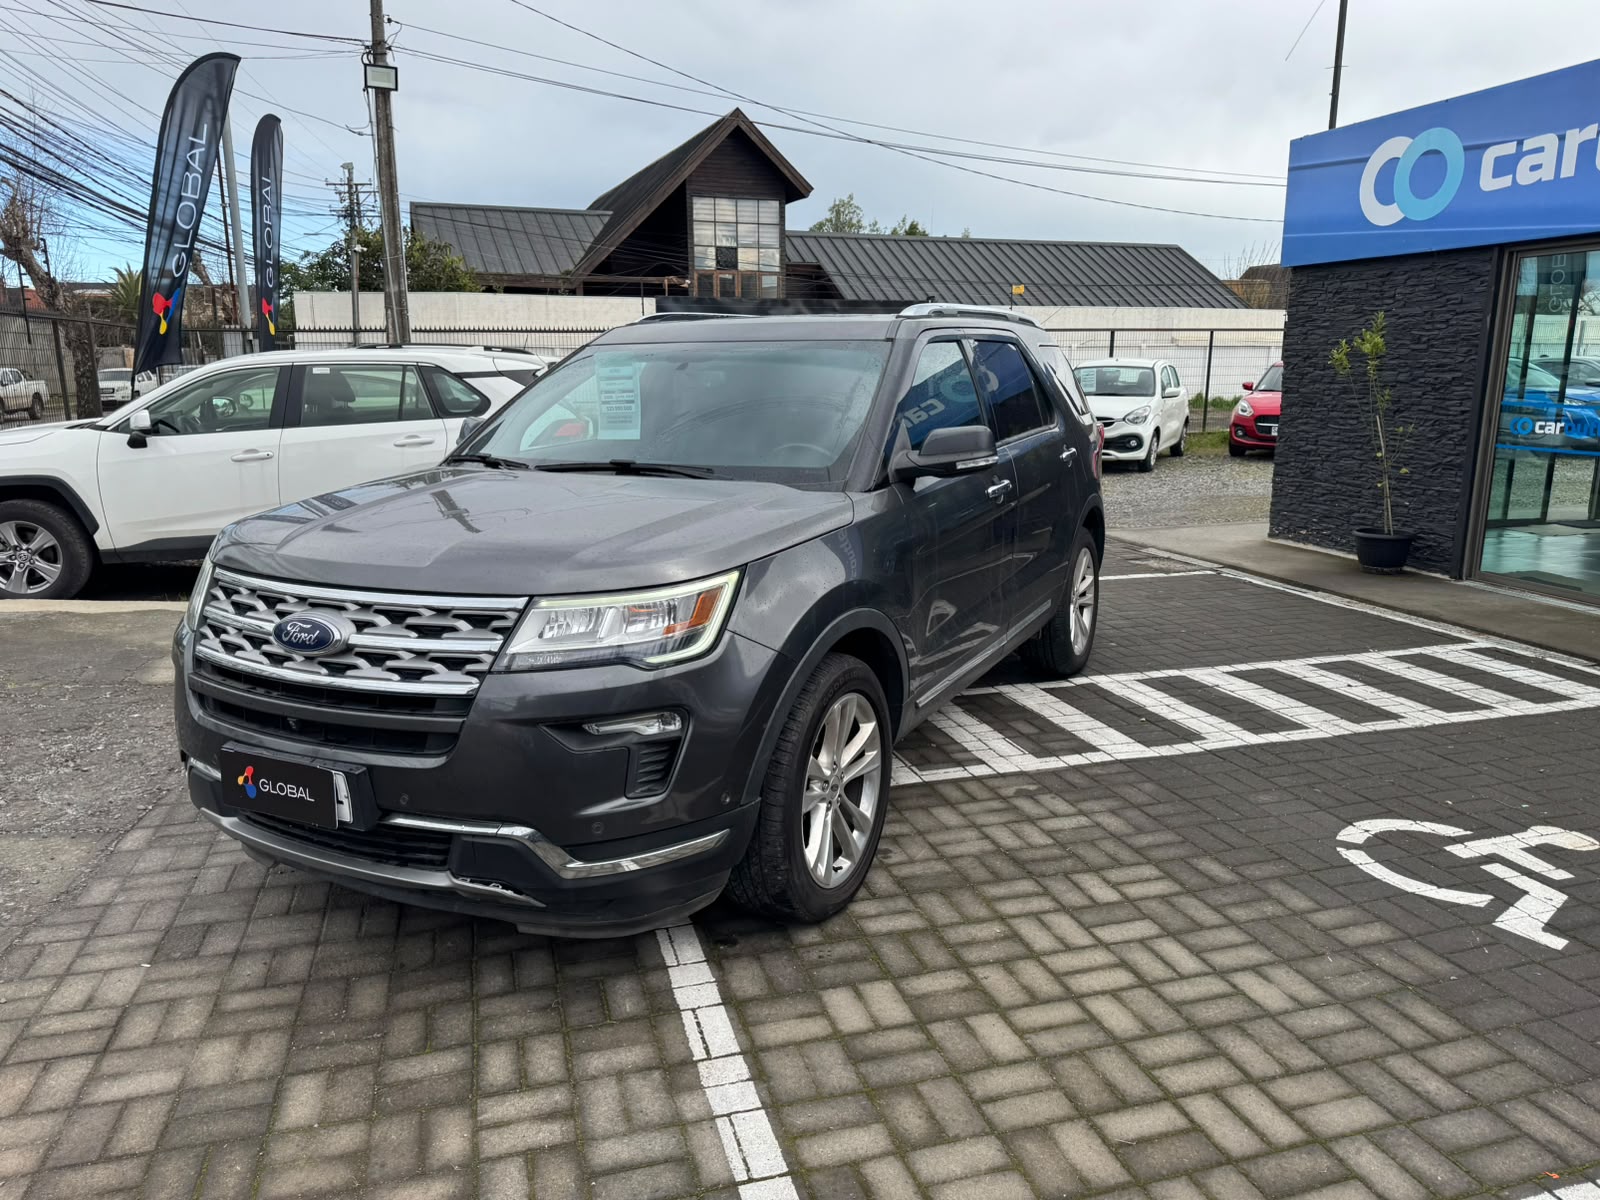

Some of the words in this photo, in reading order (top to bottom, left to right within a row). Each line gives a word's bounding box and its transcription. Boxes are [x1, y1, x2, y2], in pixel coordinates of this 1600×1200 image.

[1480, 122, 1600, 192] car
[172, 123, 208, 278] GLOBAL
[281, 621, 320, 645] Ford
[258, 778, 316, 802] GLOBAL
